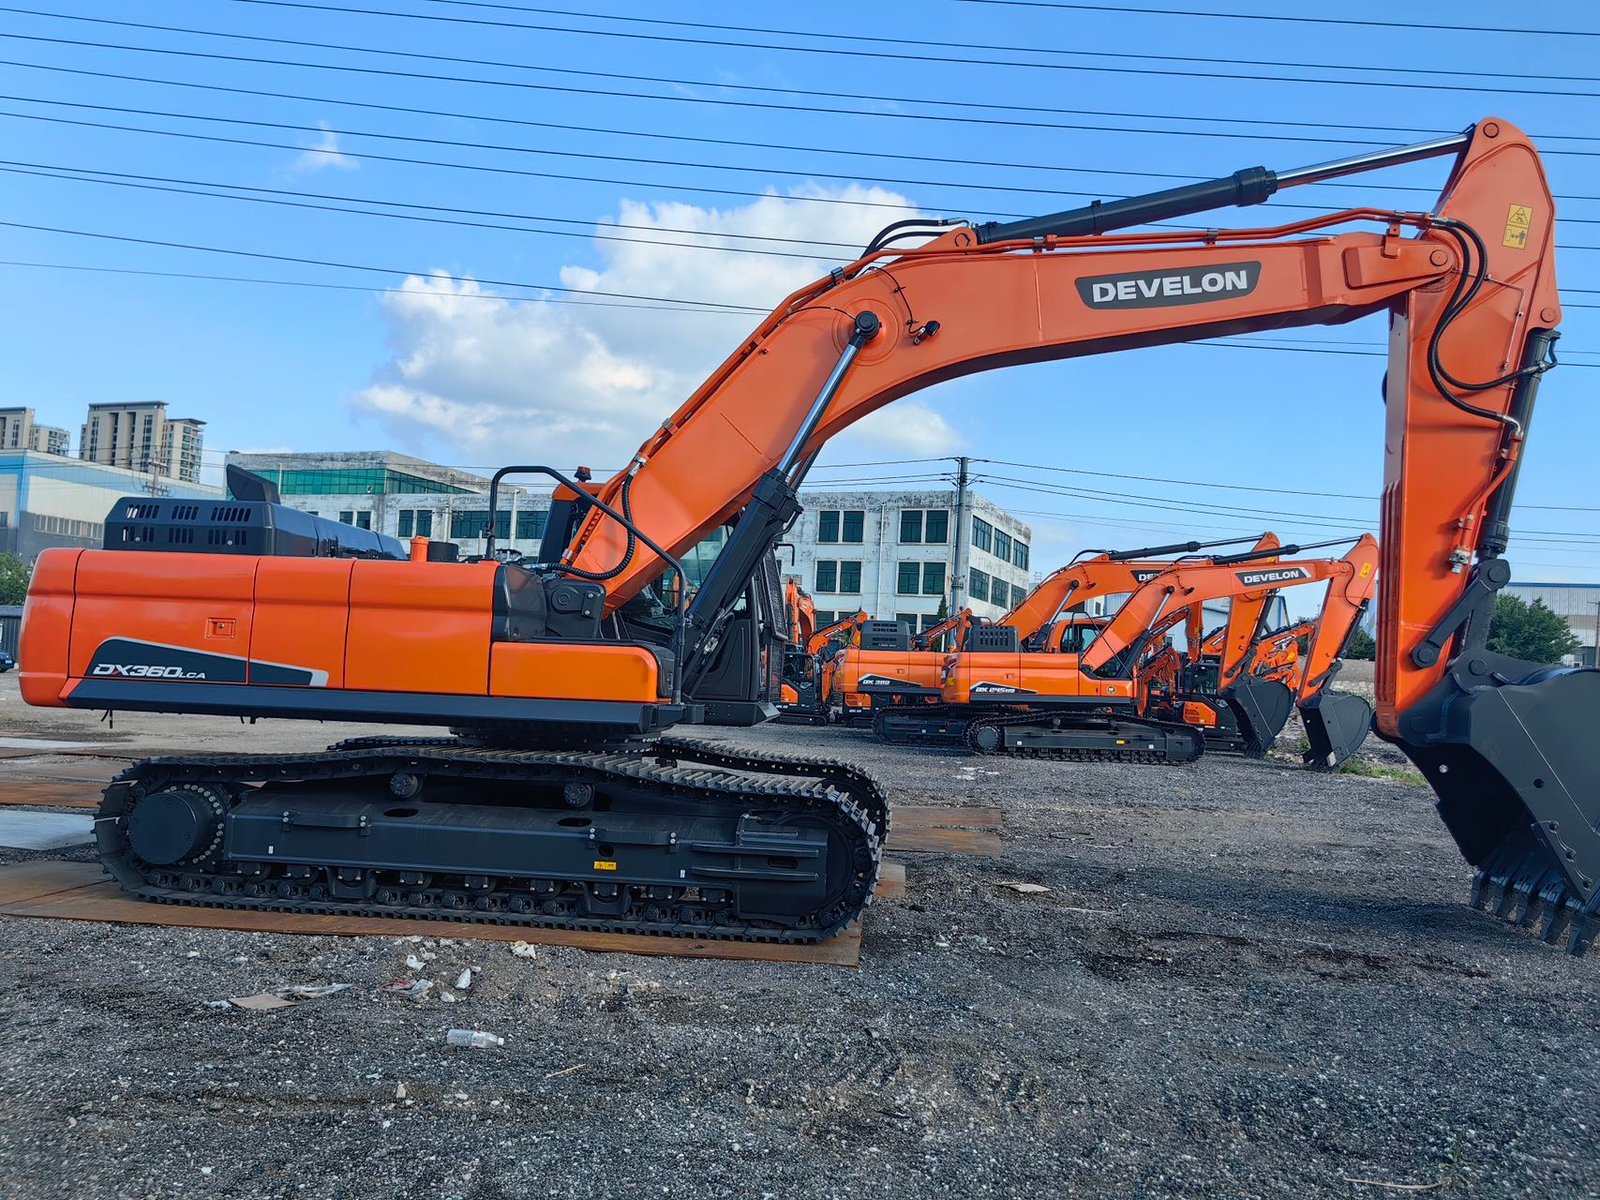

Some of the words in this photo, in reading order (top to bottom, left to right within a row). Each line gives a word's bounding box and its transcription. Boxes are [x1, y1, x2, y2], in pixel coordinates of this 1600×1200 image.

[1092, 269, 1248, 303] DEVELON
[1243, 569, 1300, 584] DEVELON
[92, 663, 206, 679] DX360LCA
